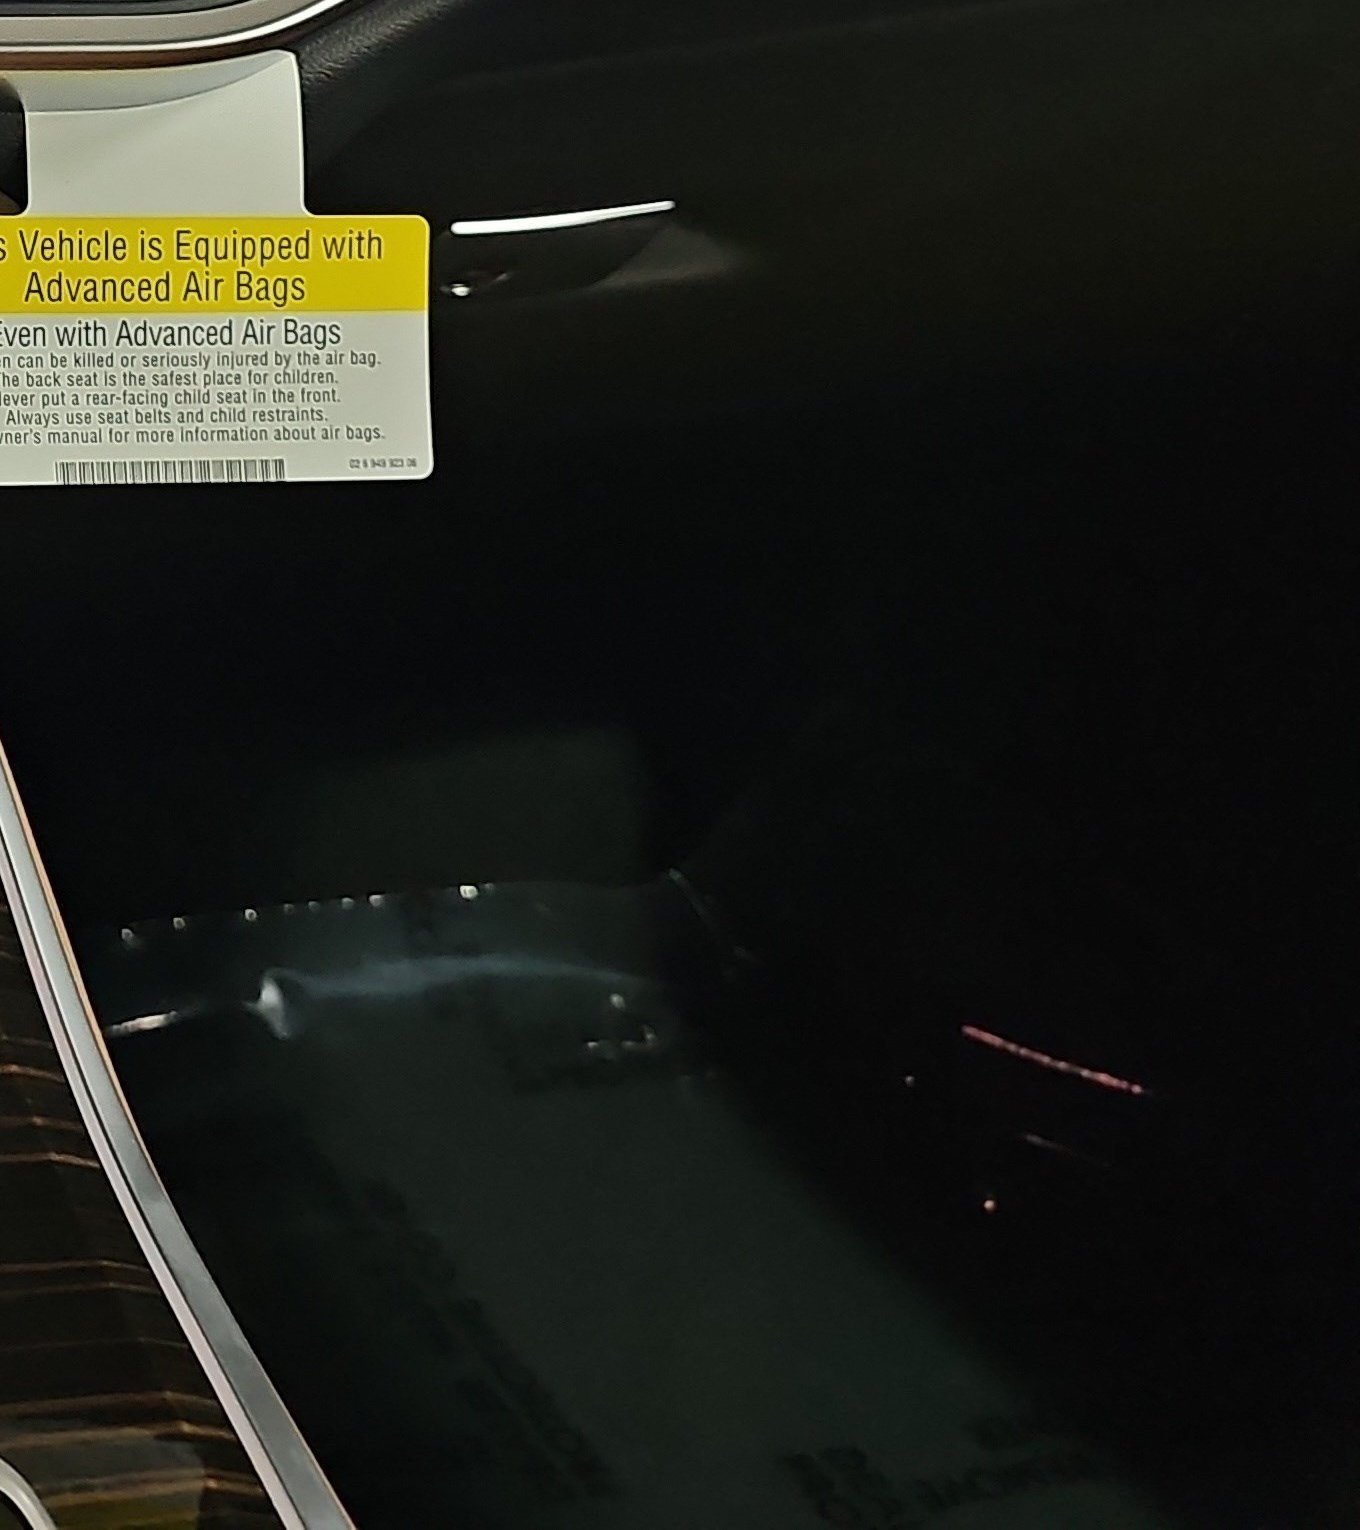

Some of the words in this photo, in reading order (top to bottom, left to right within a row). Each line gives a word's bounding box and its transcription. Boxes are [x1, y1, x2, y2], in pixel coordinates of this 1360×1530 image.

[19, 229, 127, 262] Vehicle
[140, 229, 162, 262] is
[176, 229, 311, 266] Equipped
[322, 229, 383, 260] with
[25, 272, 170, 302] Advanced
[183, 272, 223, 302] Air
[237, 271, 306, 307] Bags
[56, 320, 106, 347] with
[116, 319, 233, 347] Advanced
[242, 319, 275, 346] Air
[284, 319, 341, 349] Bags
[17, 355, 43, 369] can
[50, 353, 68, 368] be
[73, 352, 114, 368] killed
[120, 355, 136, 368] or
[142, 352, 210, 369] seriously
[216, 352, 268, 369] injured
[273, 351, 291, 369] by
[296, 351, 320, 367] the
[326, 351, 344, 367] air
[350, 351, 381, 368] bag.
[26, 371, 61, 387] back
[67, 372, 97, 387] seat
[103, 371, 116, 387] is
[122, 371, 146, 387] the
[152, 370, 197, 386] safest
[203, 370, 241, 387] place
[247, 370, 268, 386] for
[274, 370, 338, 386] children.
[41, 392, 65, 408] put
[71, 394, 80, 406] a
[86, 390, 168, 408] rear-facing
[175, 389, 211, 405] child
[217, 391, 247, 405] seat
[253, 389, 266, 405] in
[272, 389, 295, 405] the
[301, 389, 340, 405] front.
[6, 409, 60, 428] Always
[66, 413, 92, 425] use
[98, 410, 129, 424] seat
[136, 409, 171, 424] belts
[177, 409, 204, 424] and
[210, 408, 246, 424] child
[252, 408, 328, 424] restraints.
[47, 428, 102, 444] manual
[108, 428, 129, 444] for
[135, 431, 174, 444] more
[180, 427, 268, 444] information
[274, 427, 316, 443] about
[321, 427, 341, 443] air
[346, 427, 385, 443] bags.
